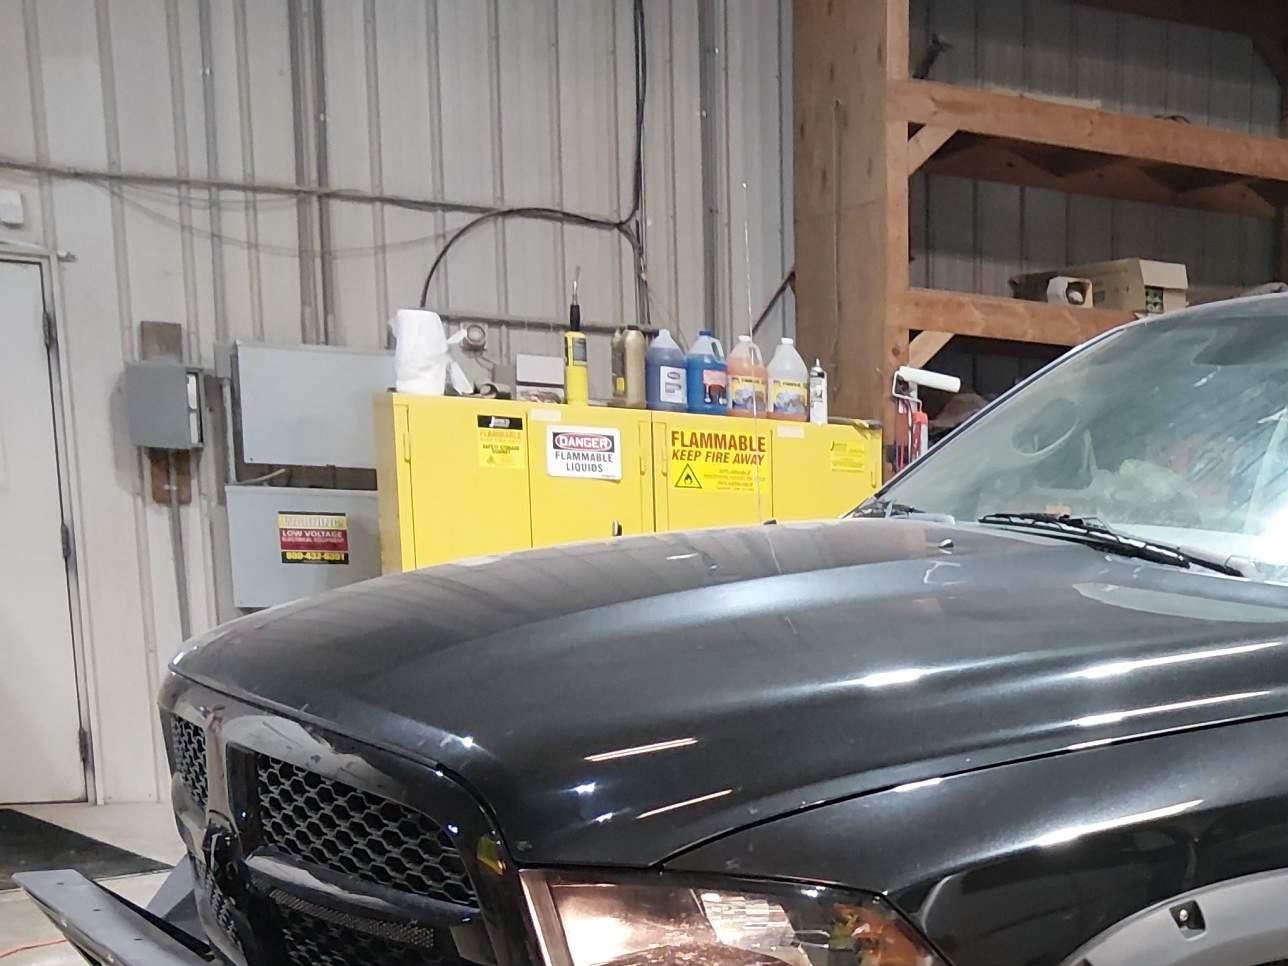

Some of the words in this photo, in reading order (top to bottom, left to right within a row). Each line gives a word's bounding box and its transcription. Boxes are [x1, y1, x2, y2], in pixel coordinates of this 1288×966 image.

[559, 434, 609, 449] DANGER
[671, 430, 766, 452] FLAMMABLE
[555, 450, 614, 463] FLAMMABLE
[672, 449, 702, 461] KEEP
[705, 450, 730, 463] FIRE
[732, 452, 765, 466] AWAY
[566, 462, 603, 473] LIQUIDS
[282, 529, 303, 538] LOW
[304, 530, 343, 538] VOLTAGE
